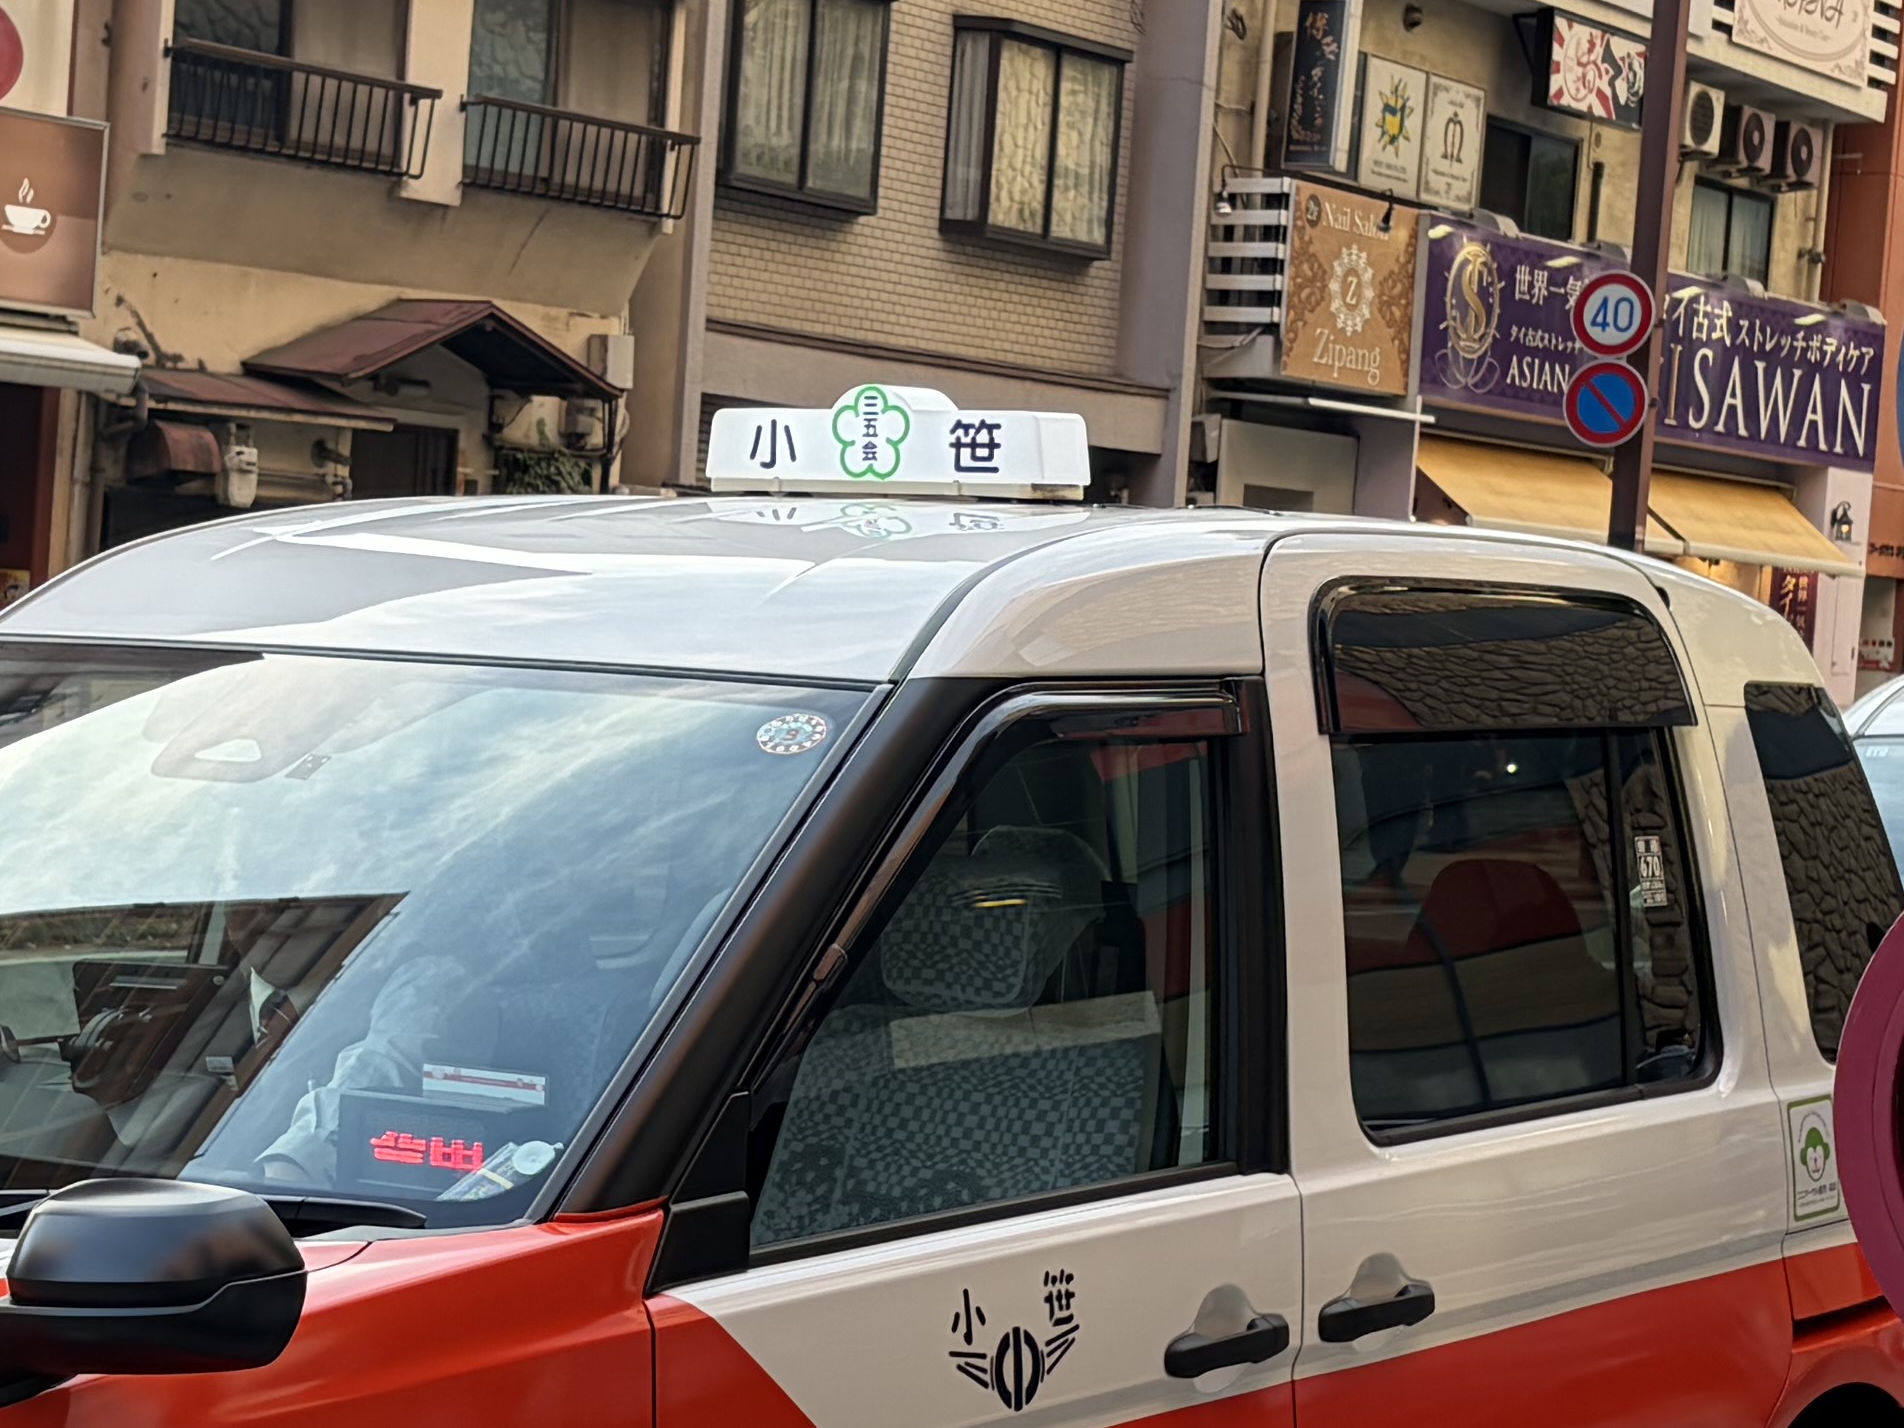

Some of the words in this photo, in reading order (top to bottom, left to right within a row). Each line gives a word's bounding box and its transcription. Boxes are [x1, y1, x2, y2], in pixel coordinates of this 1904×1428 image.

[1322, 201, 1351, 233] Nail
[1514, 264, 1588, 311] 世界一気
[1590, 295, 1636, 333] 40
[1312, 327, 1381, 386] Zipang
[1506, 354, 1571, 395] ASIAN
[749, 418, 798, 471] 小
[862, 395, 880, 463] 三五会
[948, 418, 1002, 474] 笹
